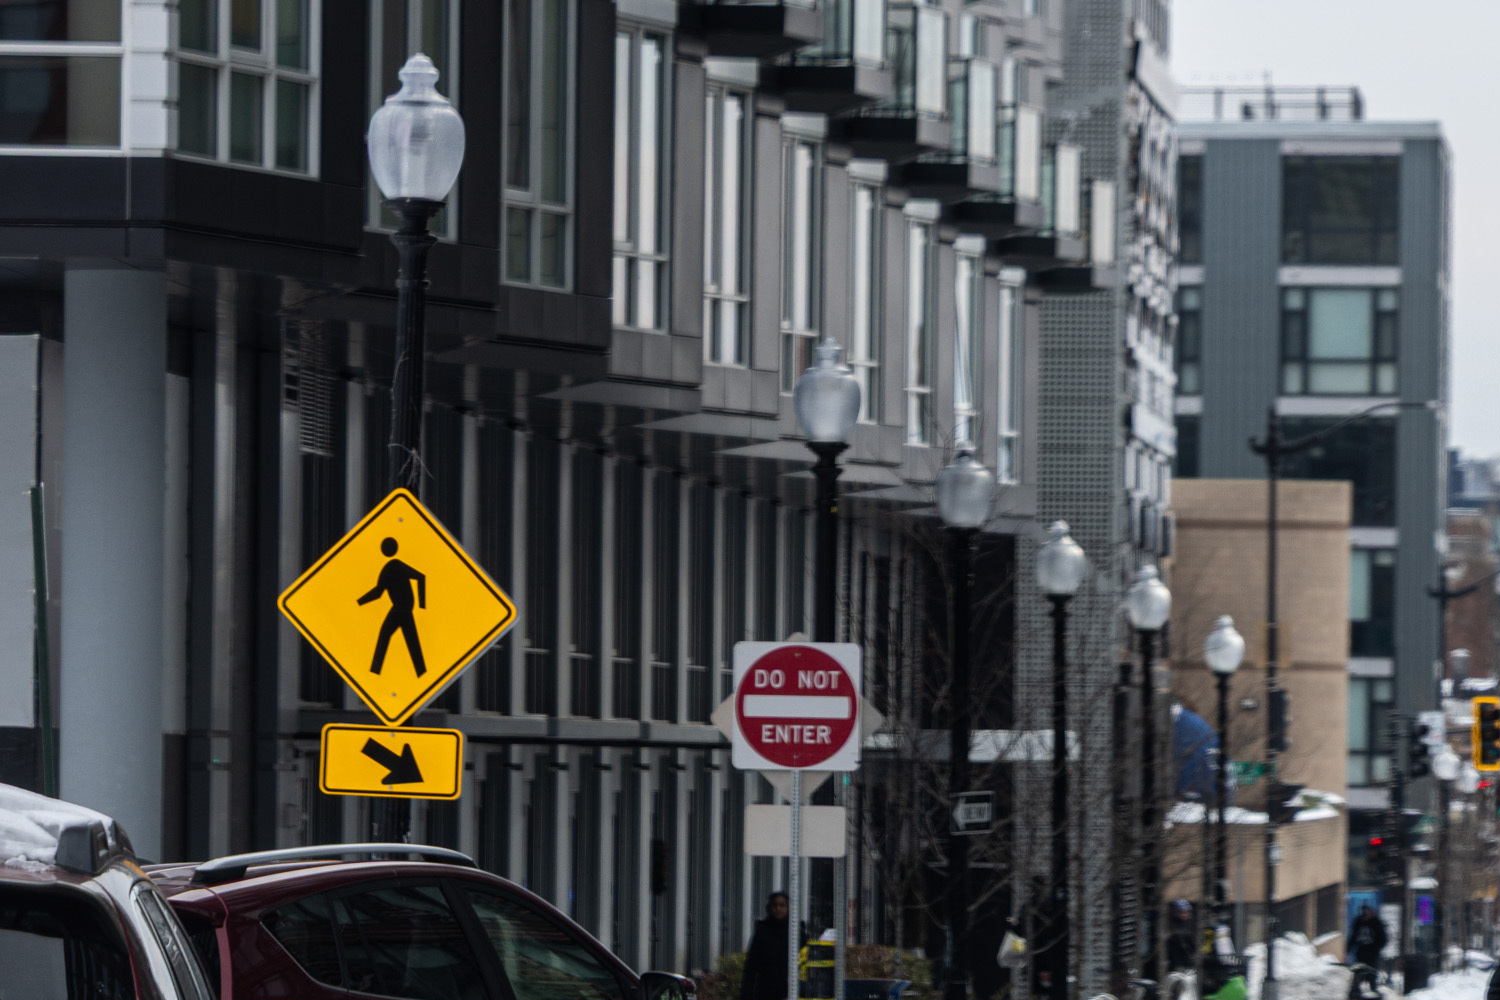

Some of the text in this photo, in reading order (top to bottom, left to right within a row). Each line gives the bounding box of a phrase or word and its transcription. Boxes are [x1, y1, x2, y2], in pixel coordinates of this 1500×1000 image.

[754, 669, 843, 690] DO NOT
[761, 724, 832, 744] ENTER
